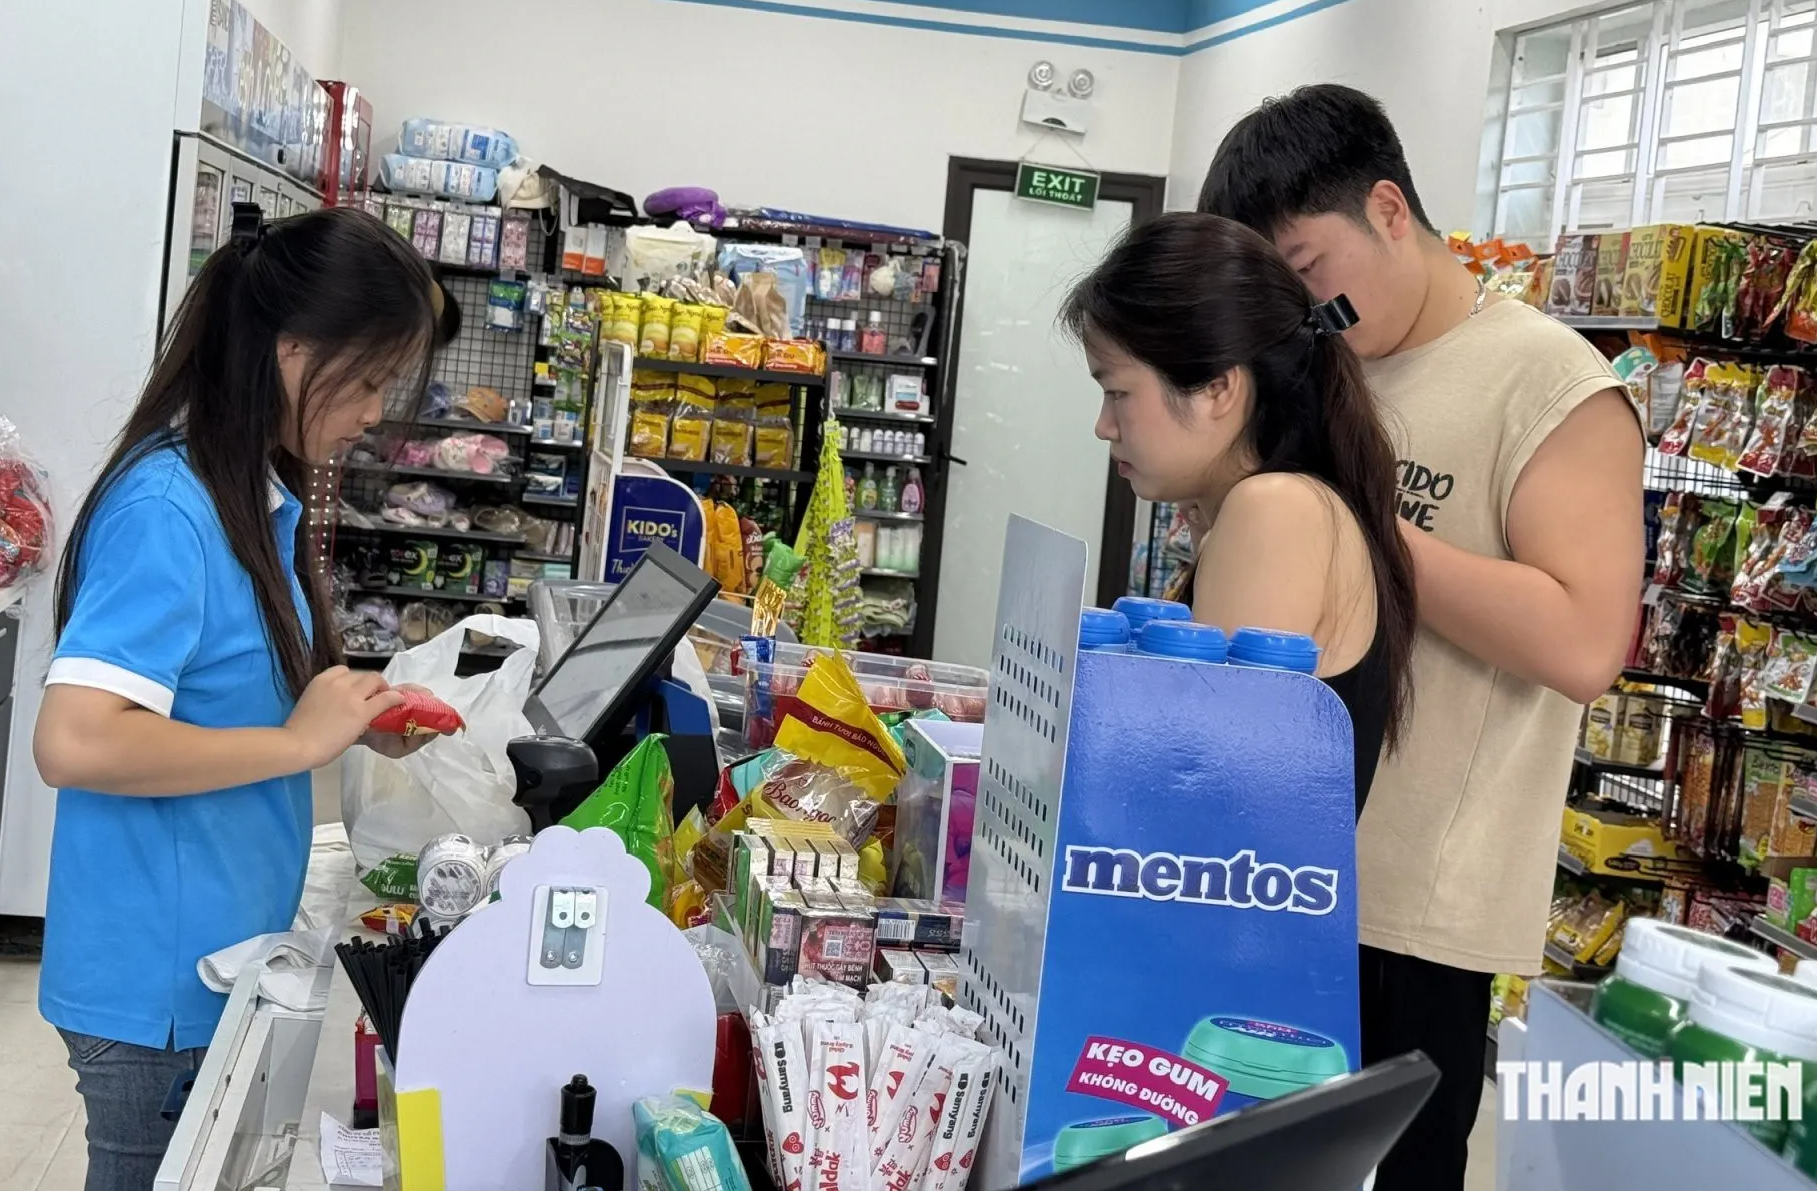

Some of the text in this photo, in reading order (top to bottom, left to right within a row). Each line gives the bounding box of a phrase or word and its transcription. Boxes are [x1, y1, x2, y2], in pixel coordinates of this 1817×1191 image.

[1032, 171, 1086, 193] EXIT
[627, 520, 678, 538] KIDO's
[1063, 846, 1338, 914] mentos
[776, 1059, 794, 1113] Samyang
[1079, 1071, 1199, 1126] KHÔNG ĐƯỜNG
[1086, 1042, 1220, 1102] KẸO GUM
